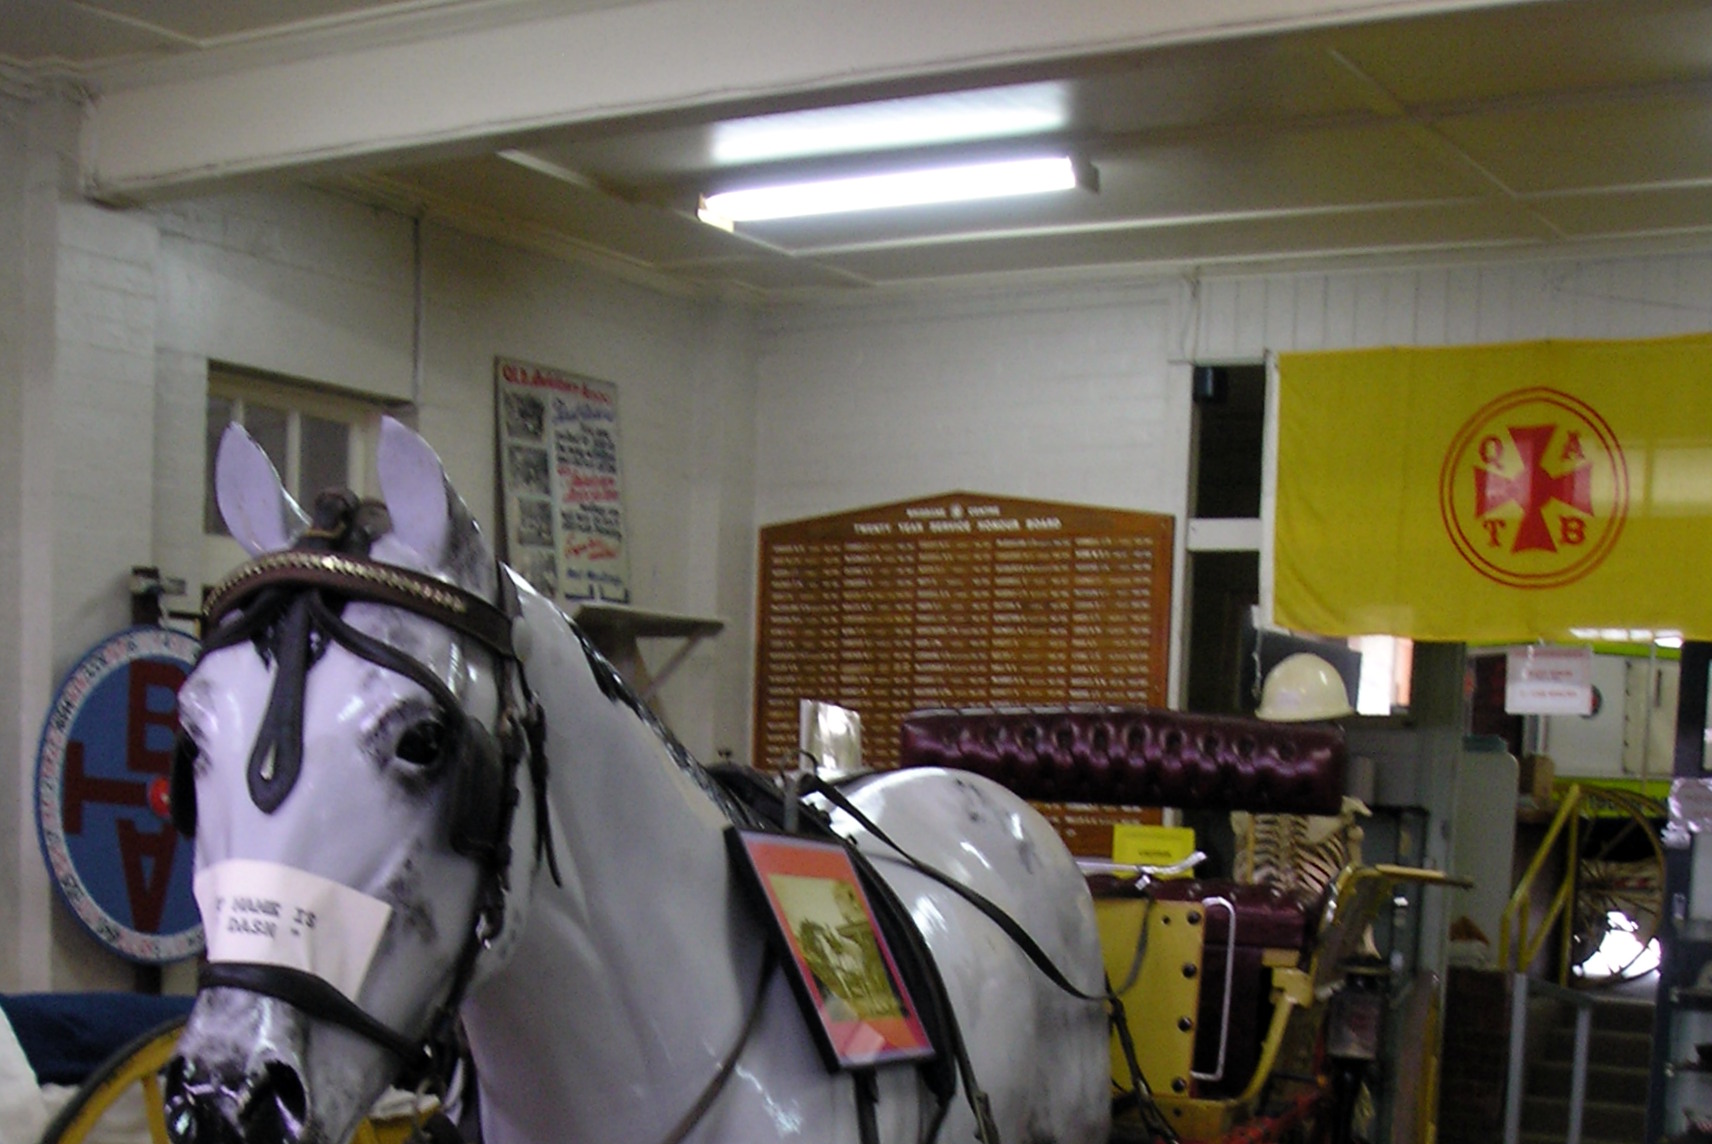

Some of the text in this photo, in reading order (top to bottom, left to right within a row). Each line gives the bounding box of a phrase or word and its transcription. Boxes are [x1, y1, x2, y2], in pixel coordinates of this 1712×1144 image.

[1479, 430, 1586, 470] Q A
[1025, 518, 1062, 532] BOARD
[1482, 515, 1586, 547] T B
